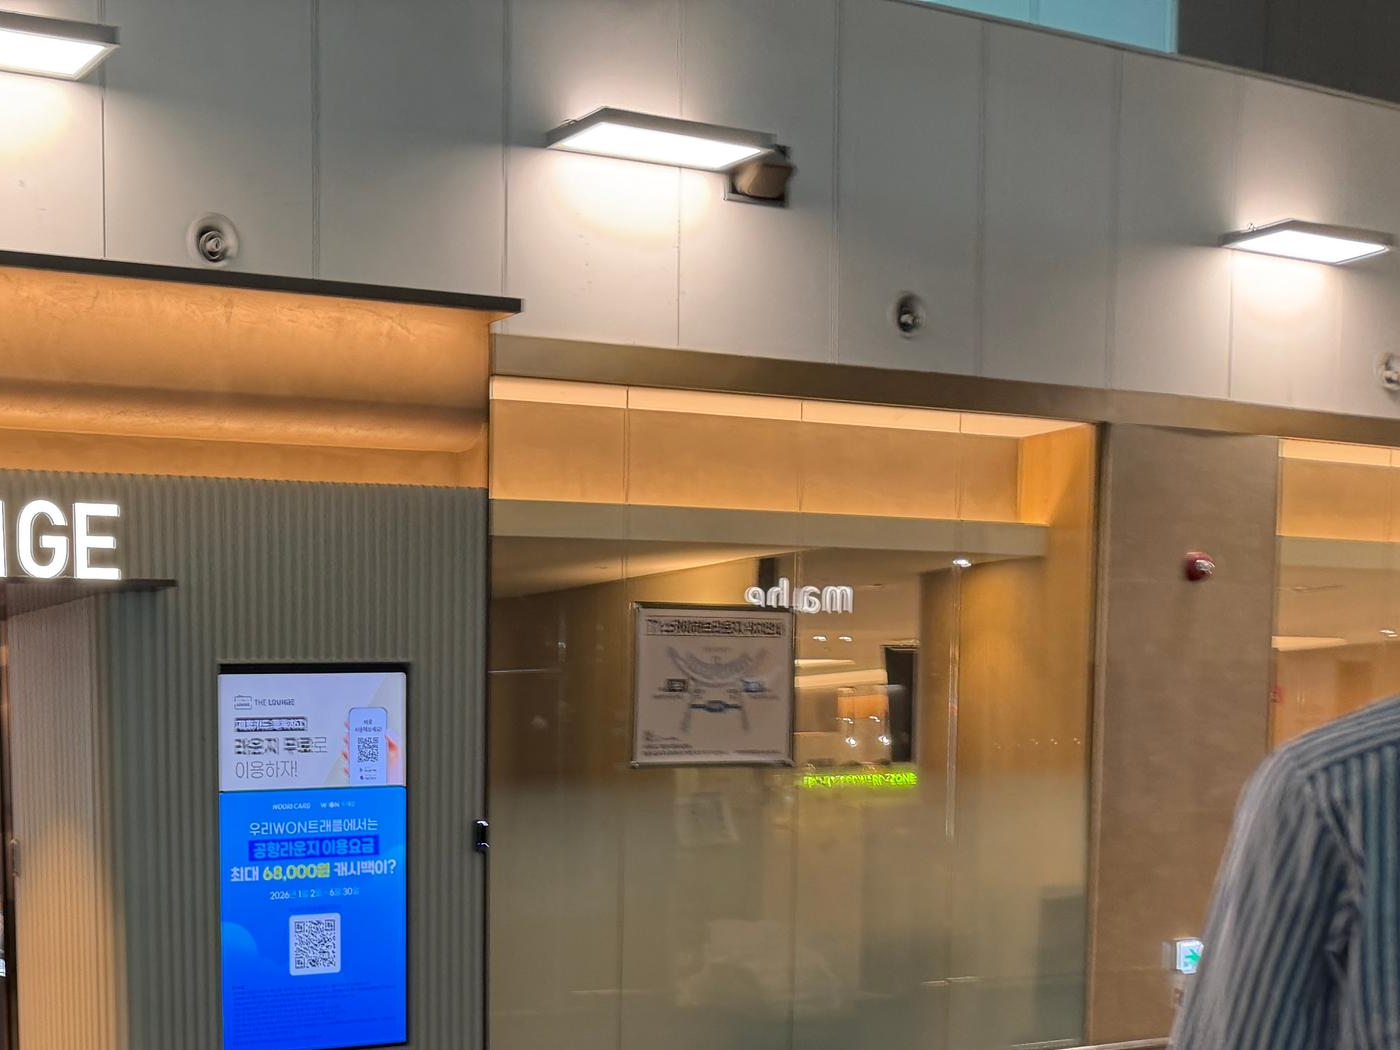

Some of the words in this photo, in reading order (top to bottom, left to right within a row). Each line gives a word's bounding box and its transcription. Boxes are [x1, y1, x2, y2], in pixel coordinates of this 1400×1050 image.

[235, 760, 298, 780] 이용하자!
[249, 818, 379, 836] 우리WON트래블에서는
[253, 839, 320, 860] 공항라운지
[322, 837, 375, 856] 이용요금
[230, 864, 260, 882] 최대
[262, 861, 331, 882] 68,000원
[333, 858, 396, 879] 캐시백이?
